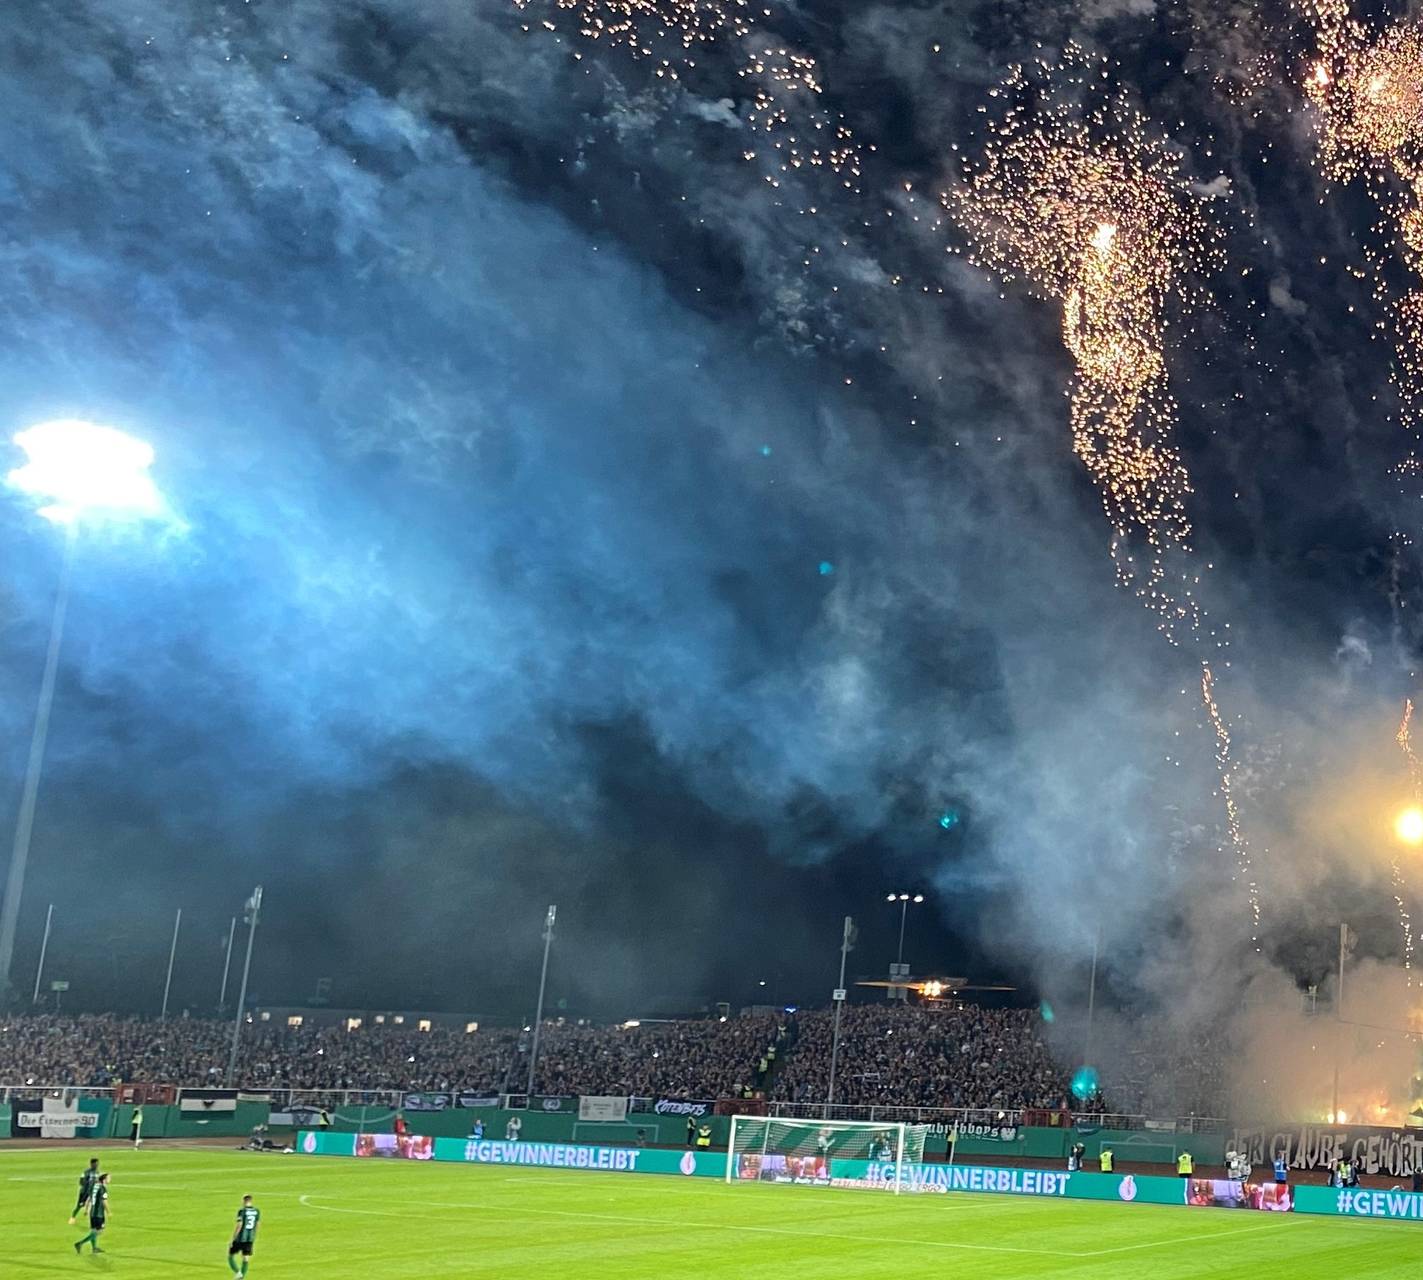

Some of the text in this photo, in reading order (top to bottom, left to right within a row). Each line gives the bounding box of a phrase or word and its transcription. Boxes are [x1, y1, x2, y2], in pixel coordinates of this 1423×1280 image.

[20, 1114, 36, 1126] Die
[80, 1114, 96, 1126] 90
[464, 1140, 640, 1170] #GEWINNERBLEIBT
[1269, 1127, 1348, 1171] GLAUBE
[865, 1162, 1071, 1195] #GEWINNERBLEIBT
[245, 1215, 256, 1229] 3
